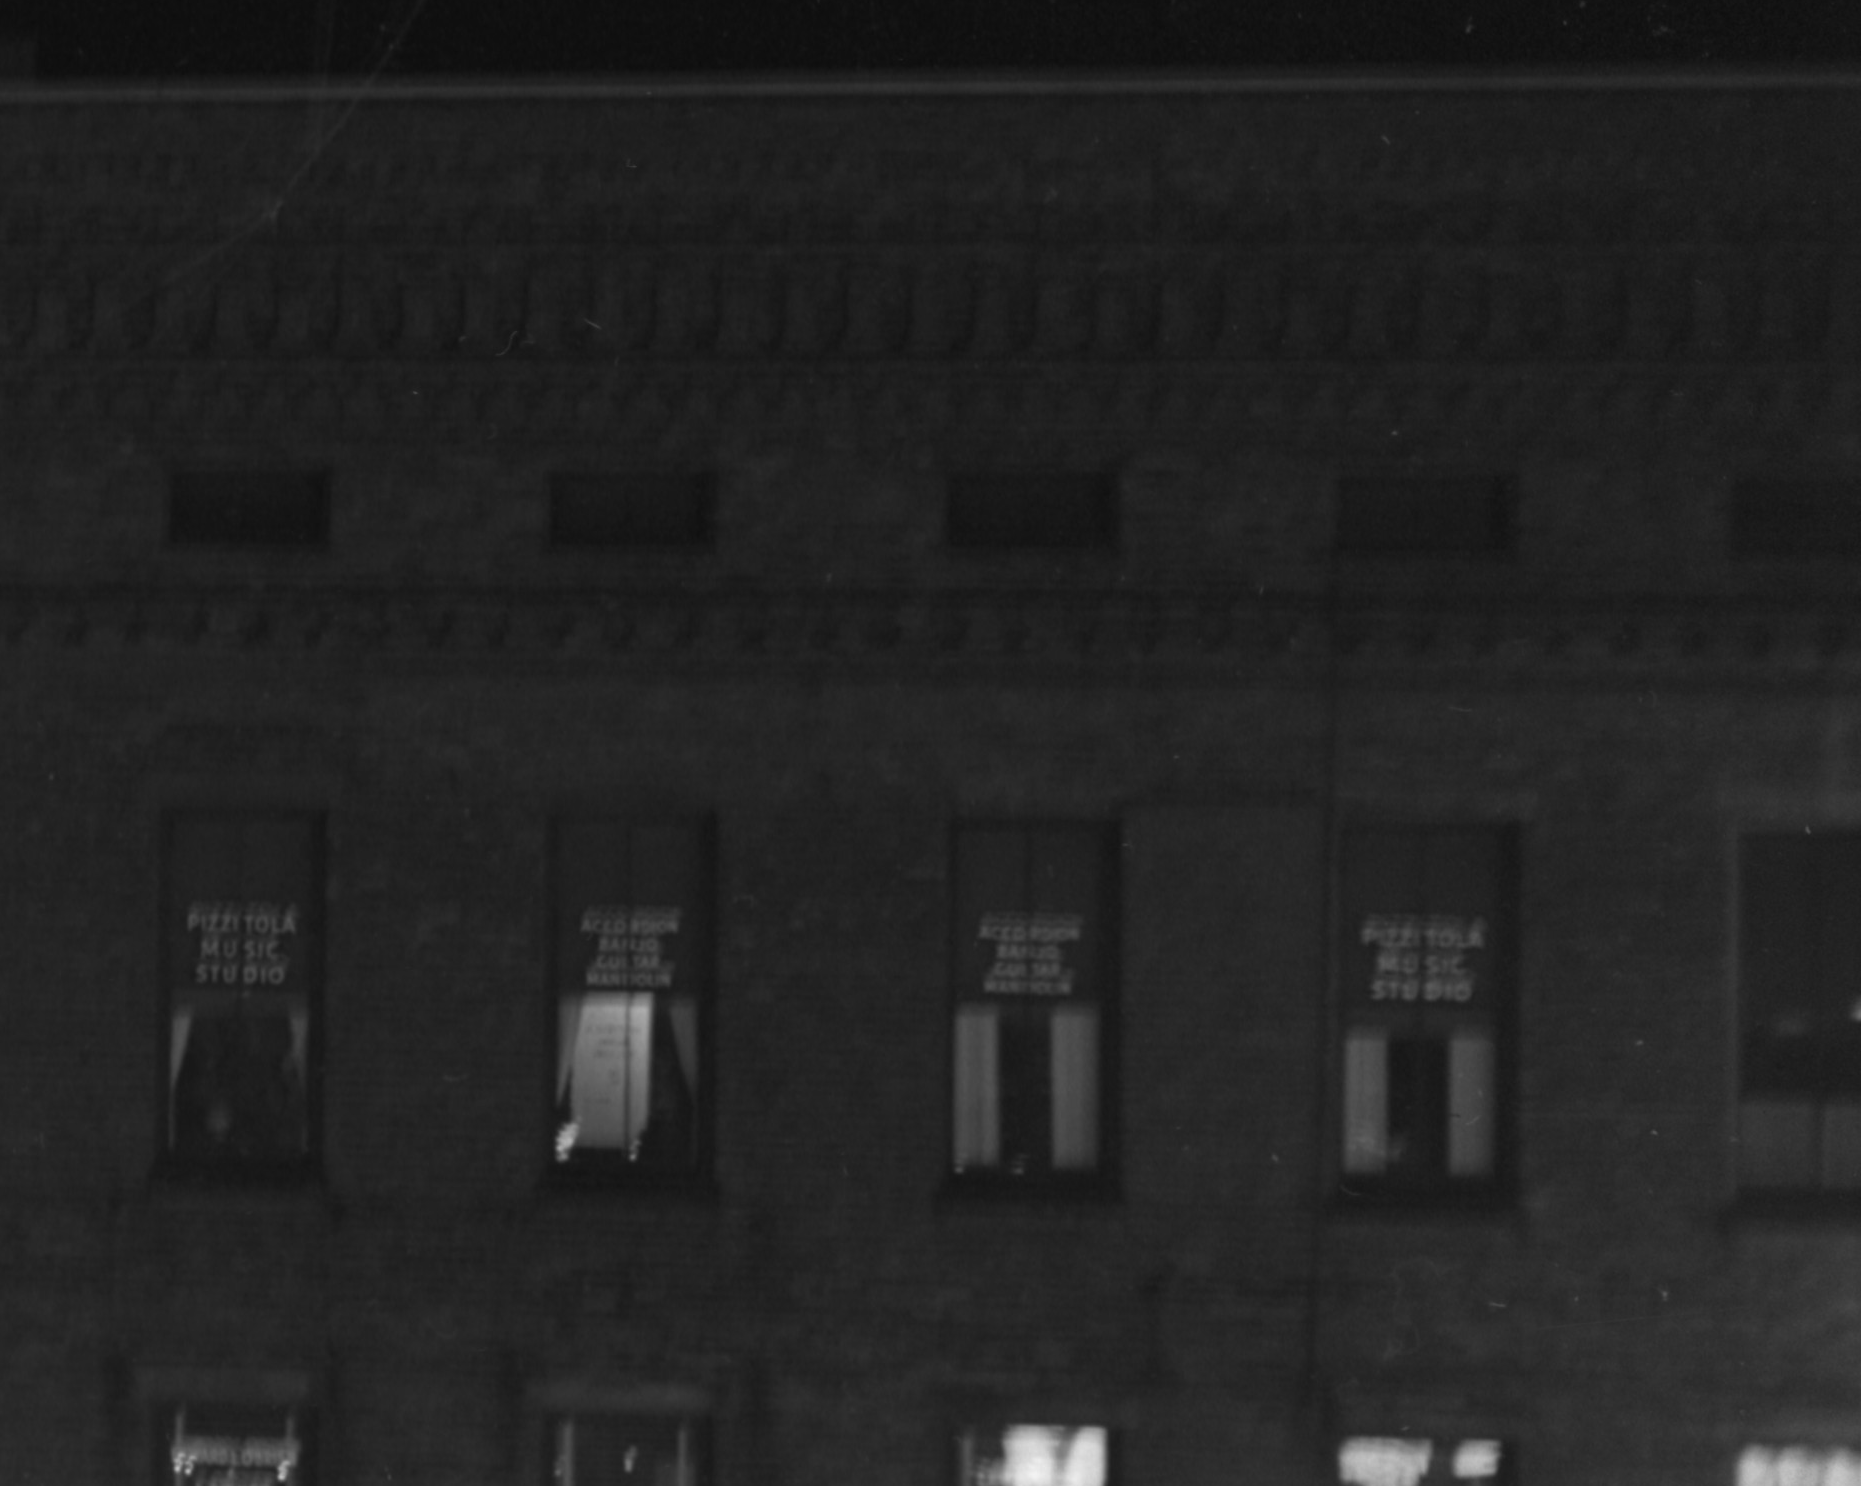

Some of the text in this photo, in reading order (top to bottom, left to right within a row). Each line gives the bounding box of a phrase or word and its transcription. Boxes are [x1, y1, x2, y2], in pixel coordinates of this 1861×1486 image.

[186, 910, 296, 935] PIZZITOLA
[199, 936, 280, 961] MUSIC
[194, 963, 287, 985] STUDIO
[1376, 950, 1467, 975] MUSIC
[1370, 978, 1474, 1002] STUDIO
